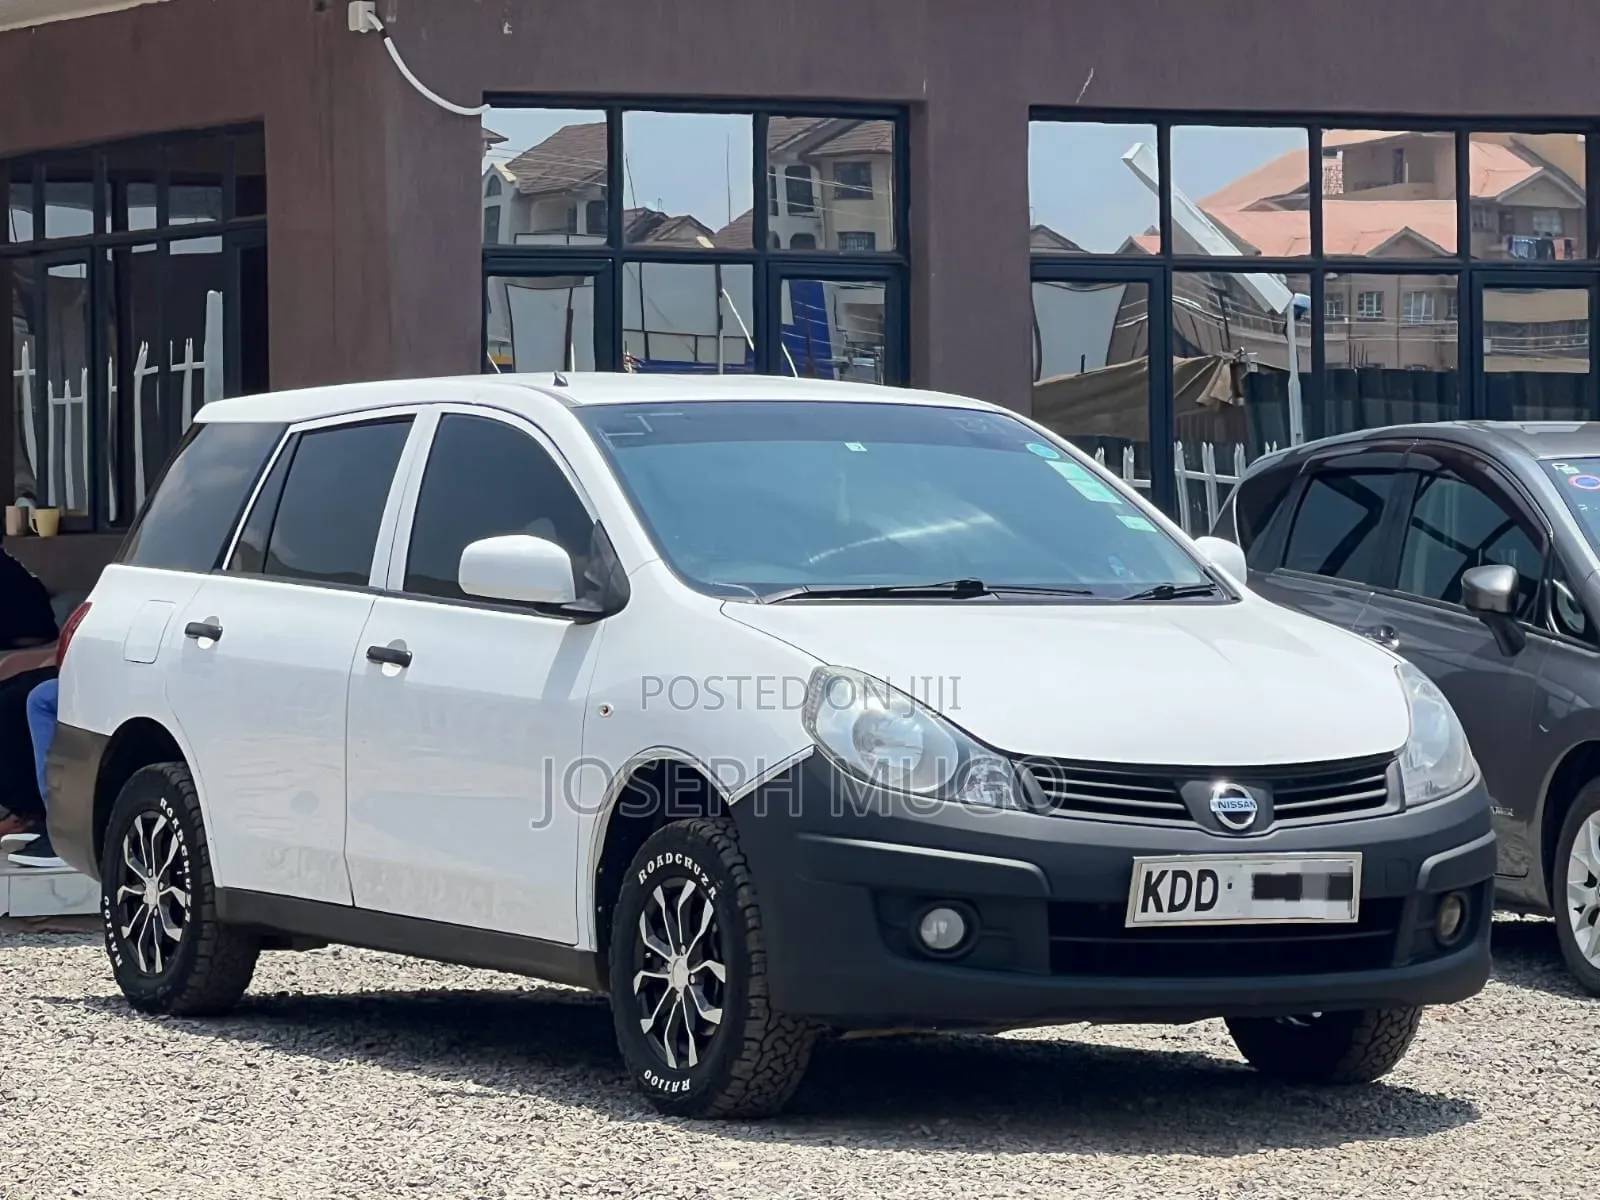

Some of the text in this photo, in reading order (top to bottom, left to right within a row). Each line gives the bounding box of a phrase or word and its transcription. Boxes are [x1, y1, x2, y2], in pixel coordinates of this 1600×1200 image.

[1218, 800, 1256, 809] NISSAN
[638, 852, 717, 900] ROADCRUZA
[1140, 869, 1219, 913] KDD
